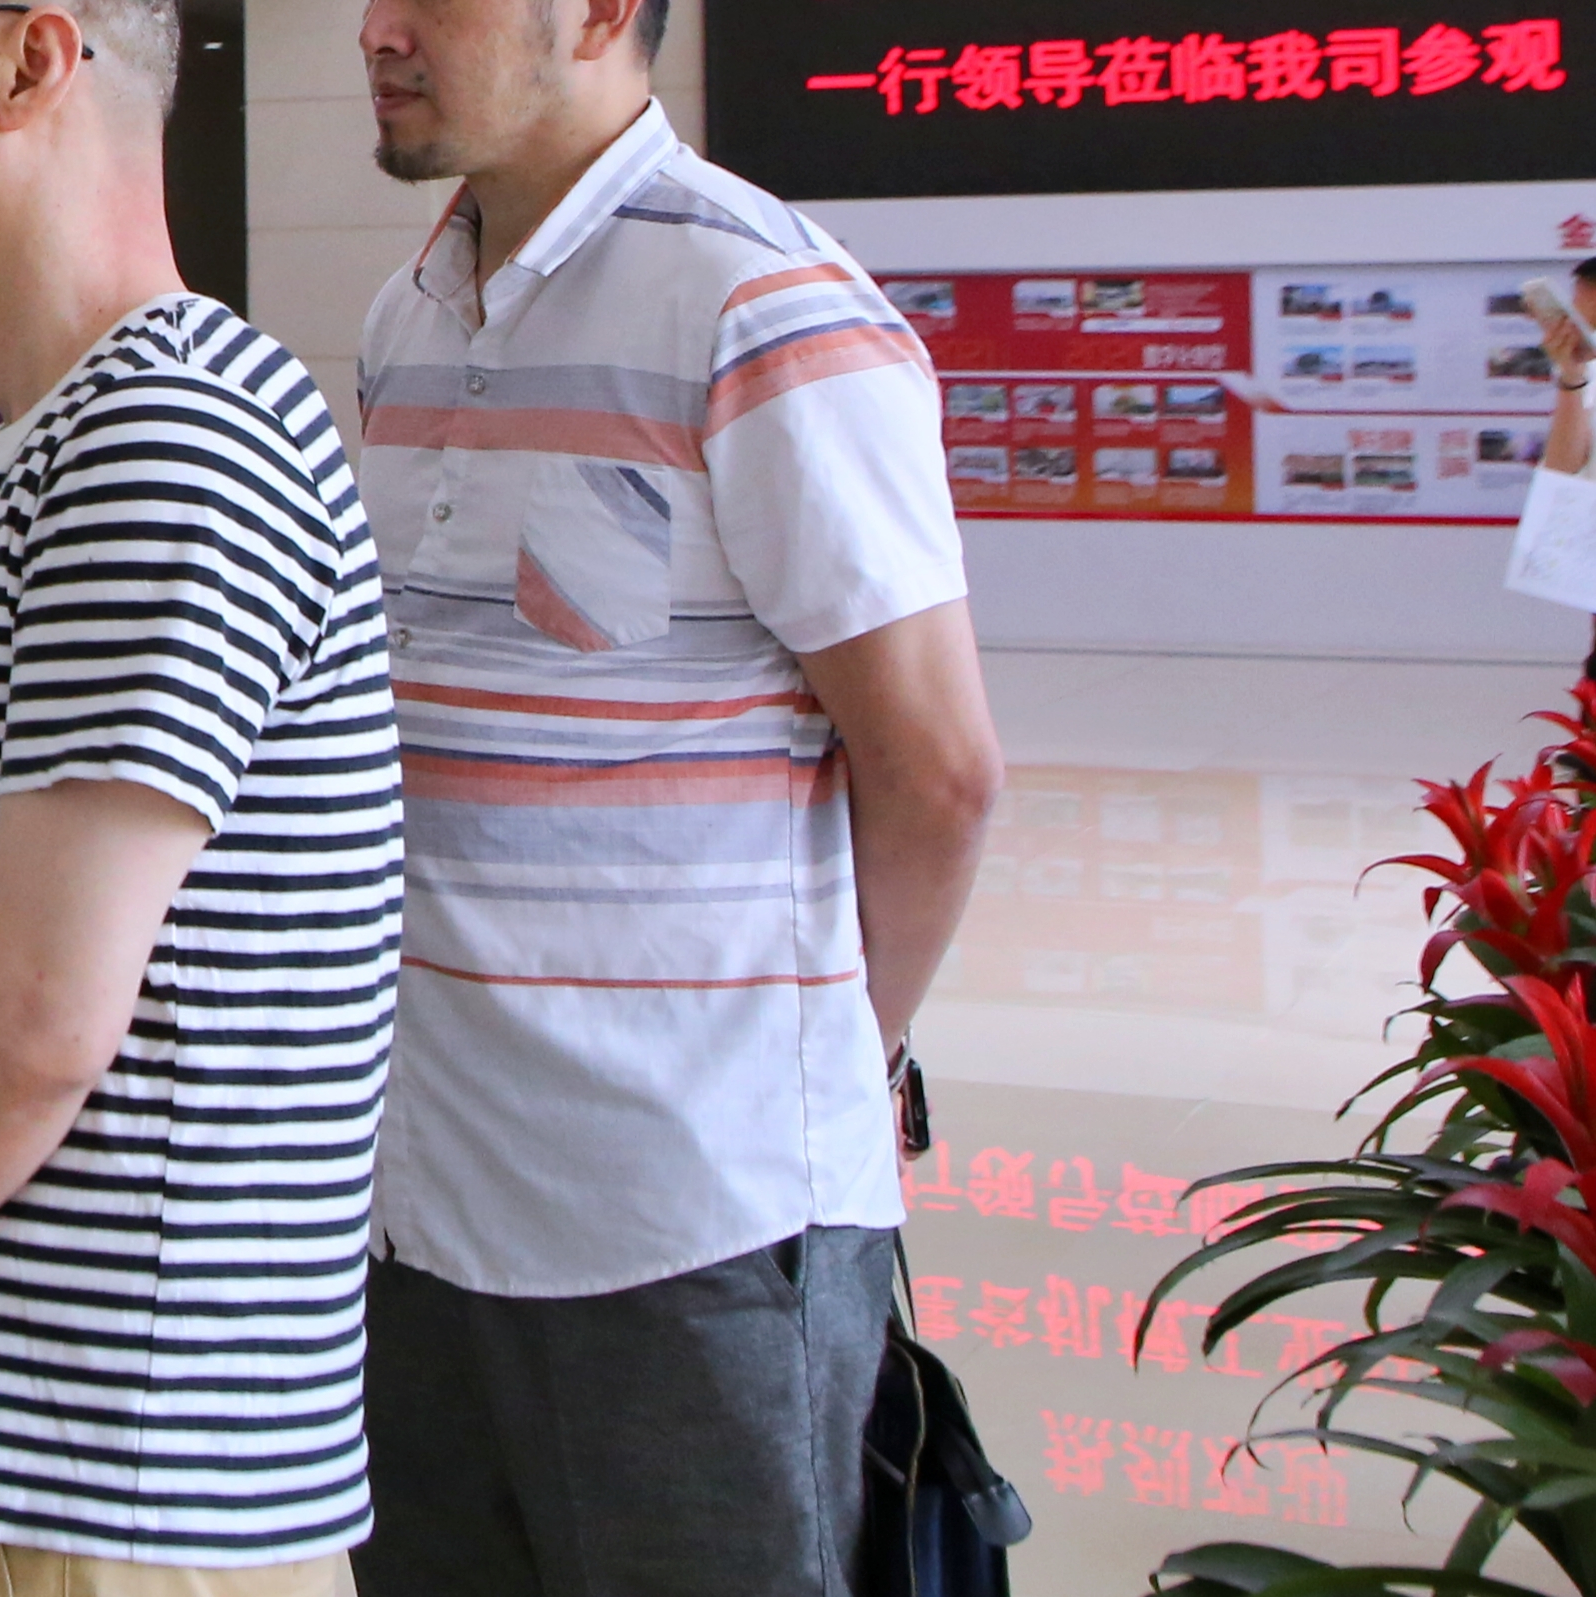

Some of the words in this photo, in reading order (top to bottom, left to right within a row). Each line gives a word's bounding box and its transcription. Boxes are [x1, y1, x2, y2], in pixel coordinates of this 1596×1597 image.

[806, 17, 1568, 116] 一行领导莅临我司参观
